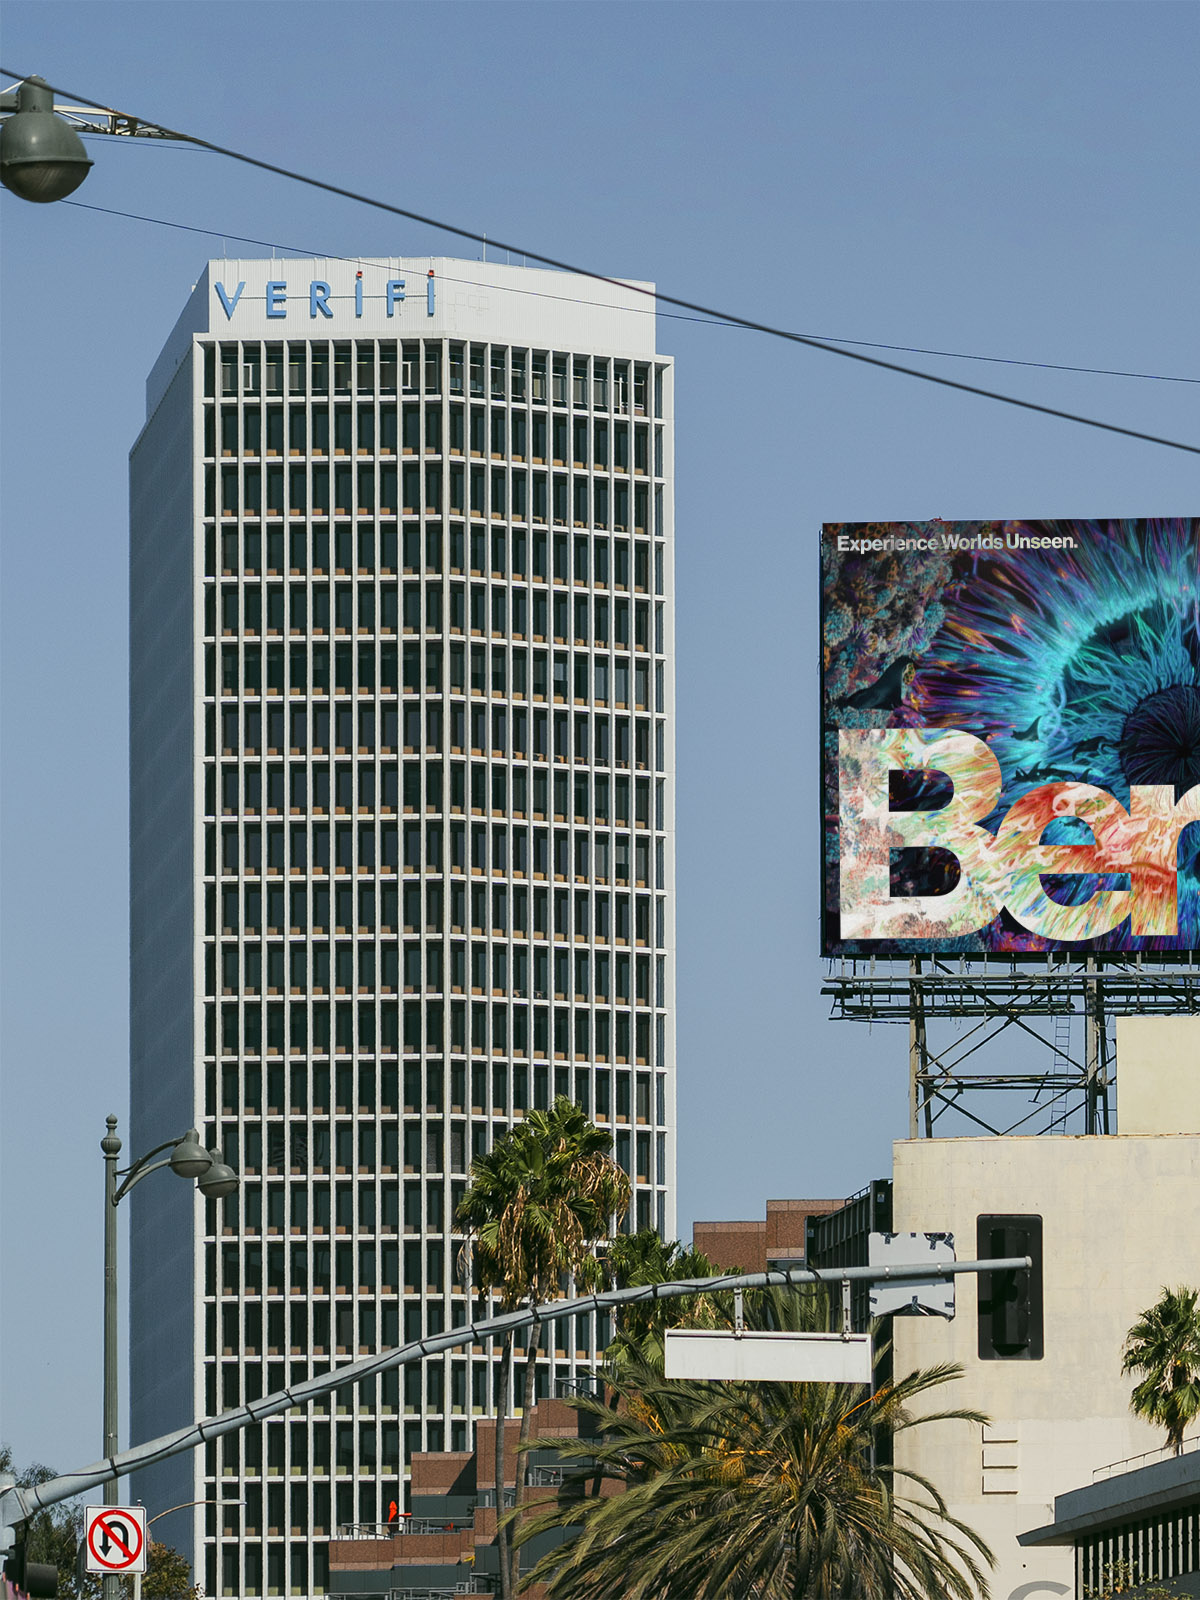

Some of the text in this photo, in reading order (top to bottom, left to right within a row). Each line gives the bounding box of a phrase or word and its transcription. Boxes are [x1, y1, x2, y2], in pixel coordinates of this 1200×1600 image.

[837, 532, 1079, 555] Experience Worlds Unseen.
